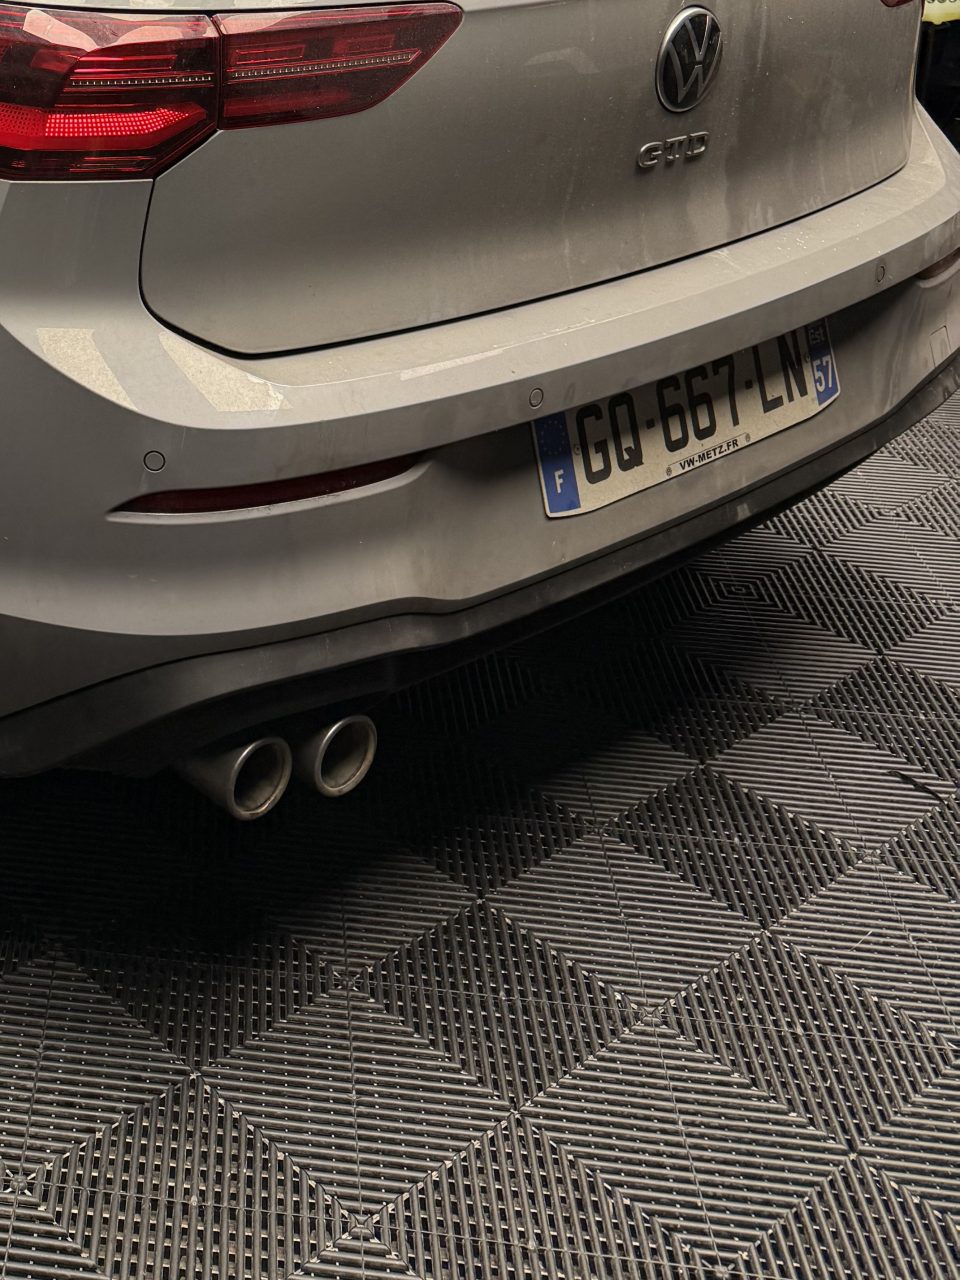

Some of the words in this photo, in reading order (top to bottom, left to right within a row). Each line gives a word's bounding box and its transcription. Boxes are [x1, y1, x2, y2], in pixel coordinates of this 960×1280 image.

[638, 131, 709, 168] GTD
[813, 355, 833, 393] 57
[575, 330, 808, 485] GQ-667-LN
[679, 438, 739, 471] VW-METZ.FR
[553, 470, 565, 494] F
